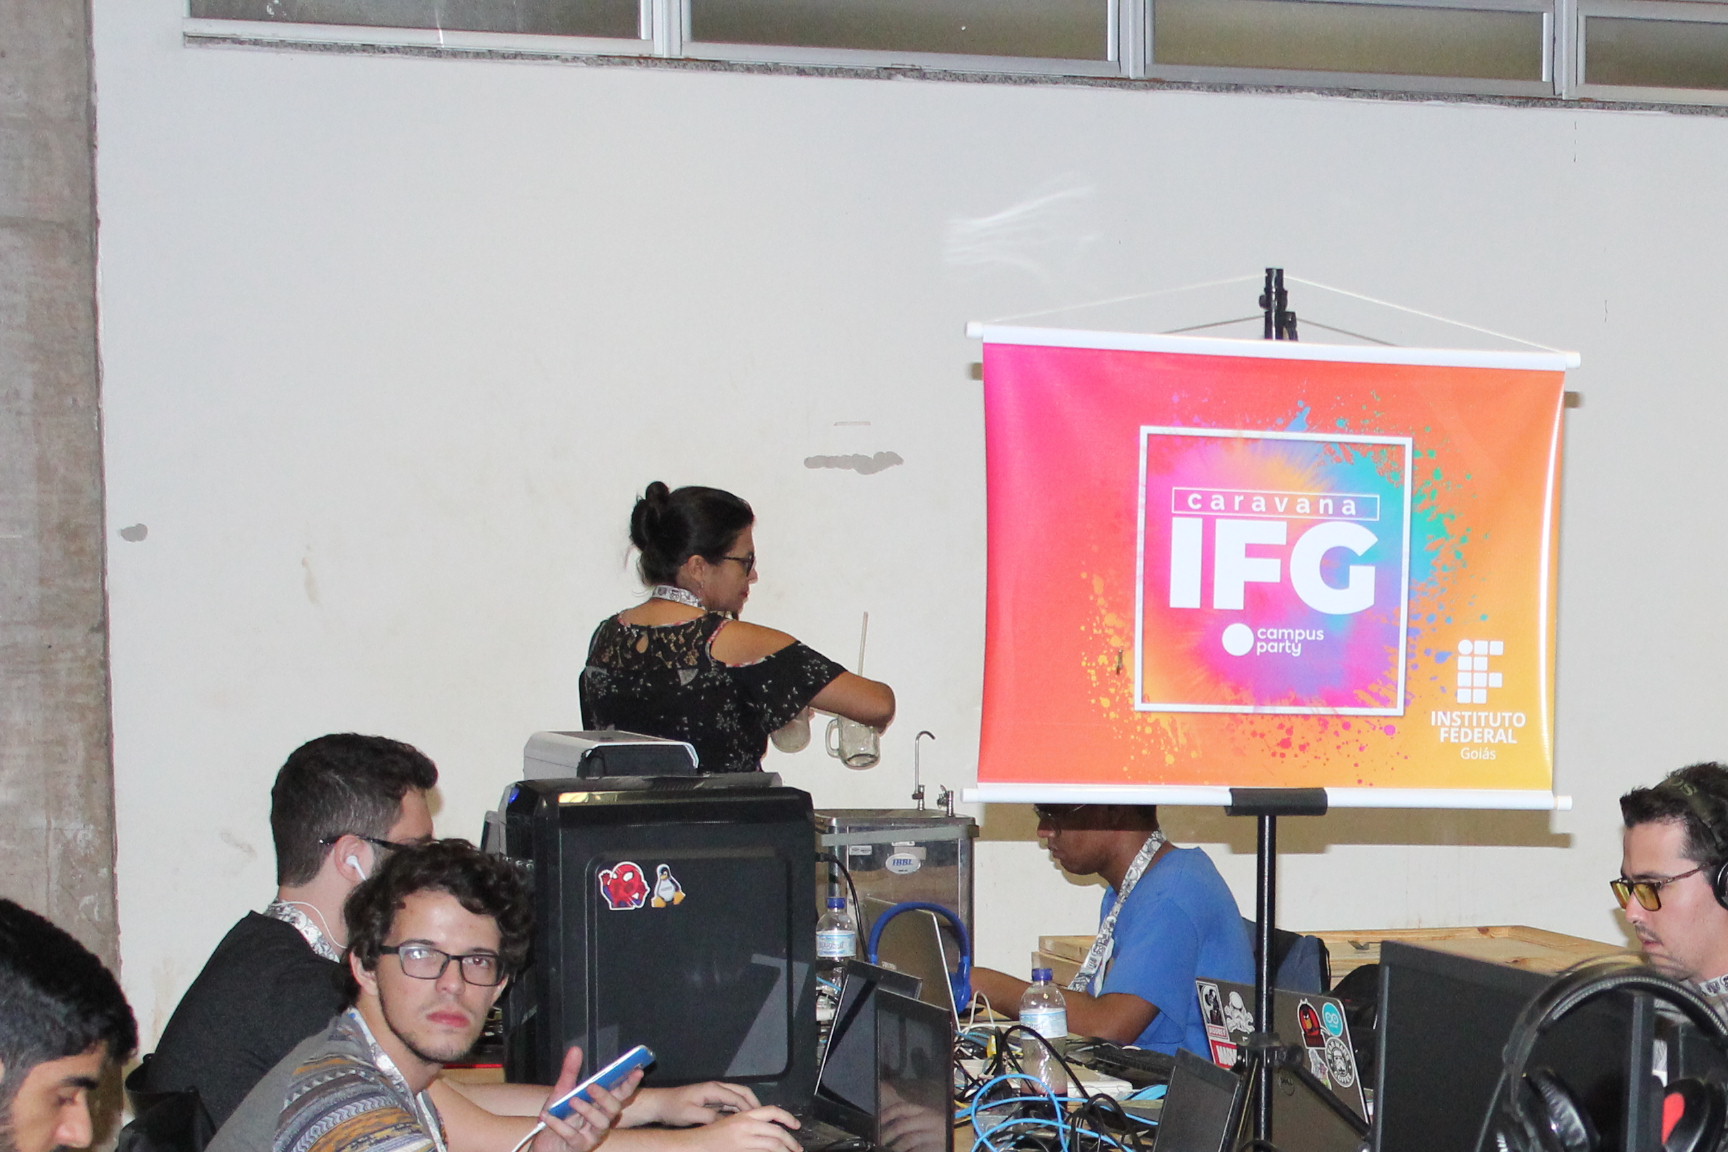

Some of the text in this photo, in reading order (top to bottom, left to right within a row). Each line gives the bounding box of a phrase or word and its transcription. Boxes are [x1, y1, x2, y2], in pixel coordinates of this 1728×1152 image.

[1187, 493, 1356, 516] caravana
[1169, 516, 1379, 615] IFG
[1257, 627, 1325, 643] campus
[1256, 640, 1302, 656] party
[1431, 710, 1526, 728] INSTITUTO
[1439, 727, 1518, 744] FEDERAL
[1460, 746, 1497, 760] Goiás
